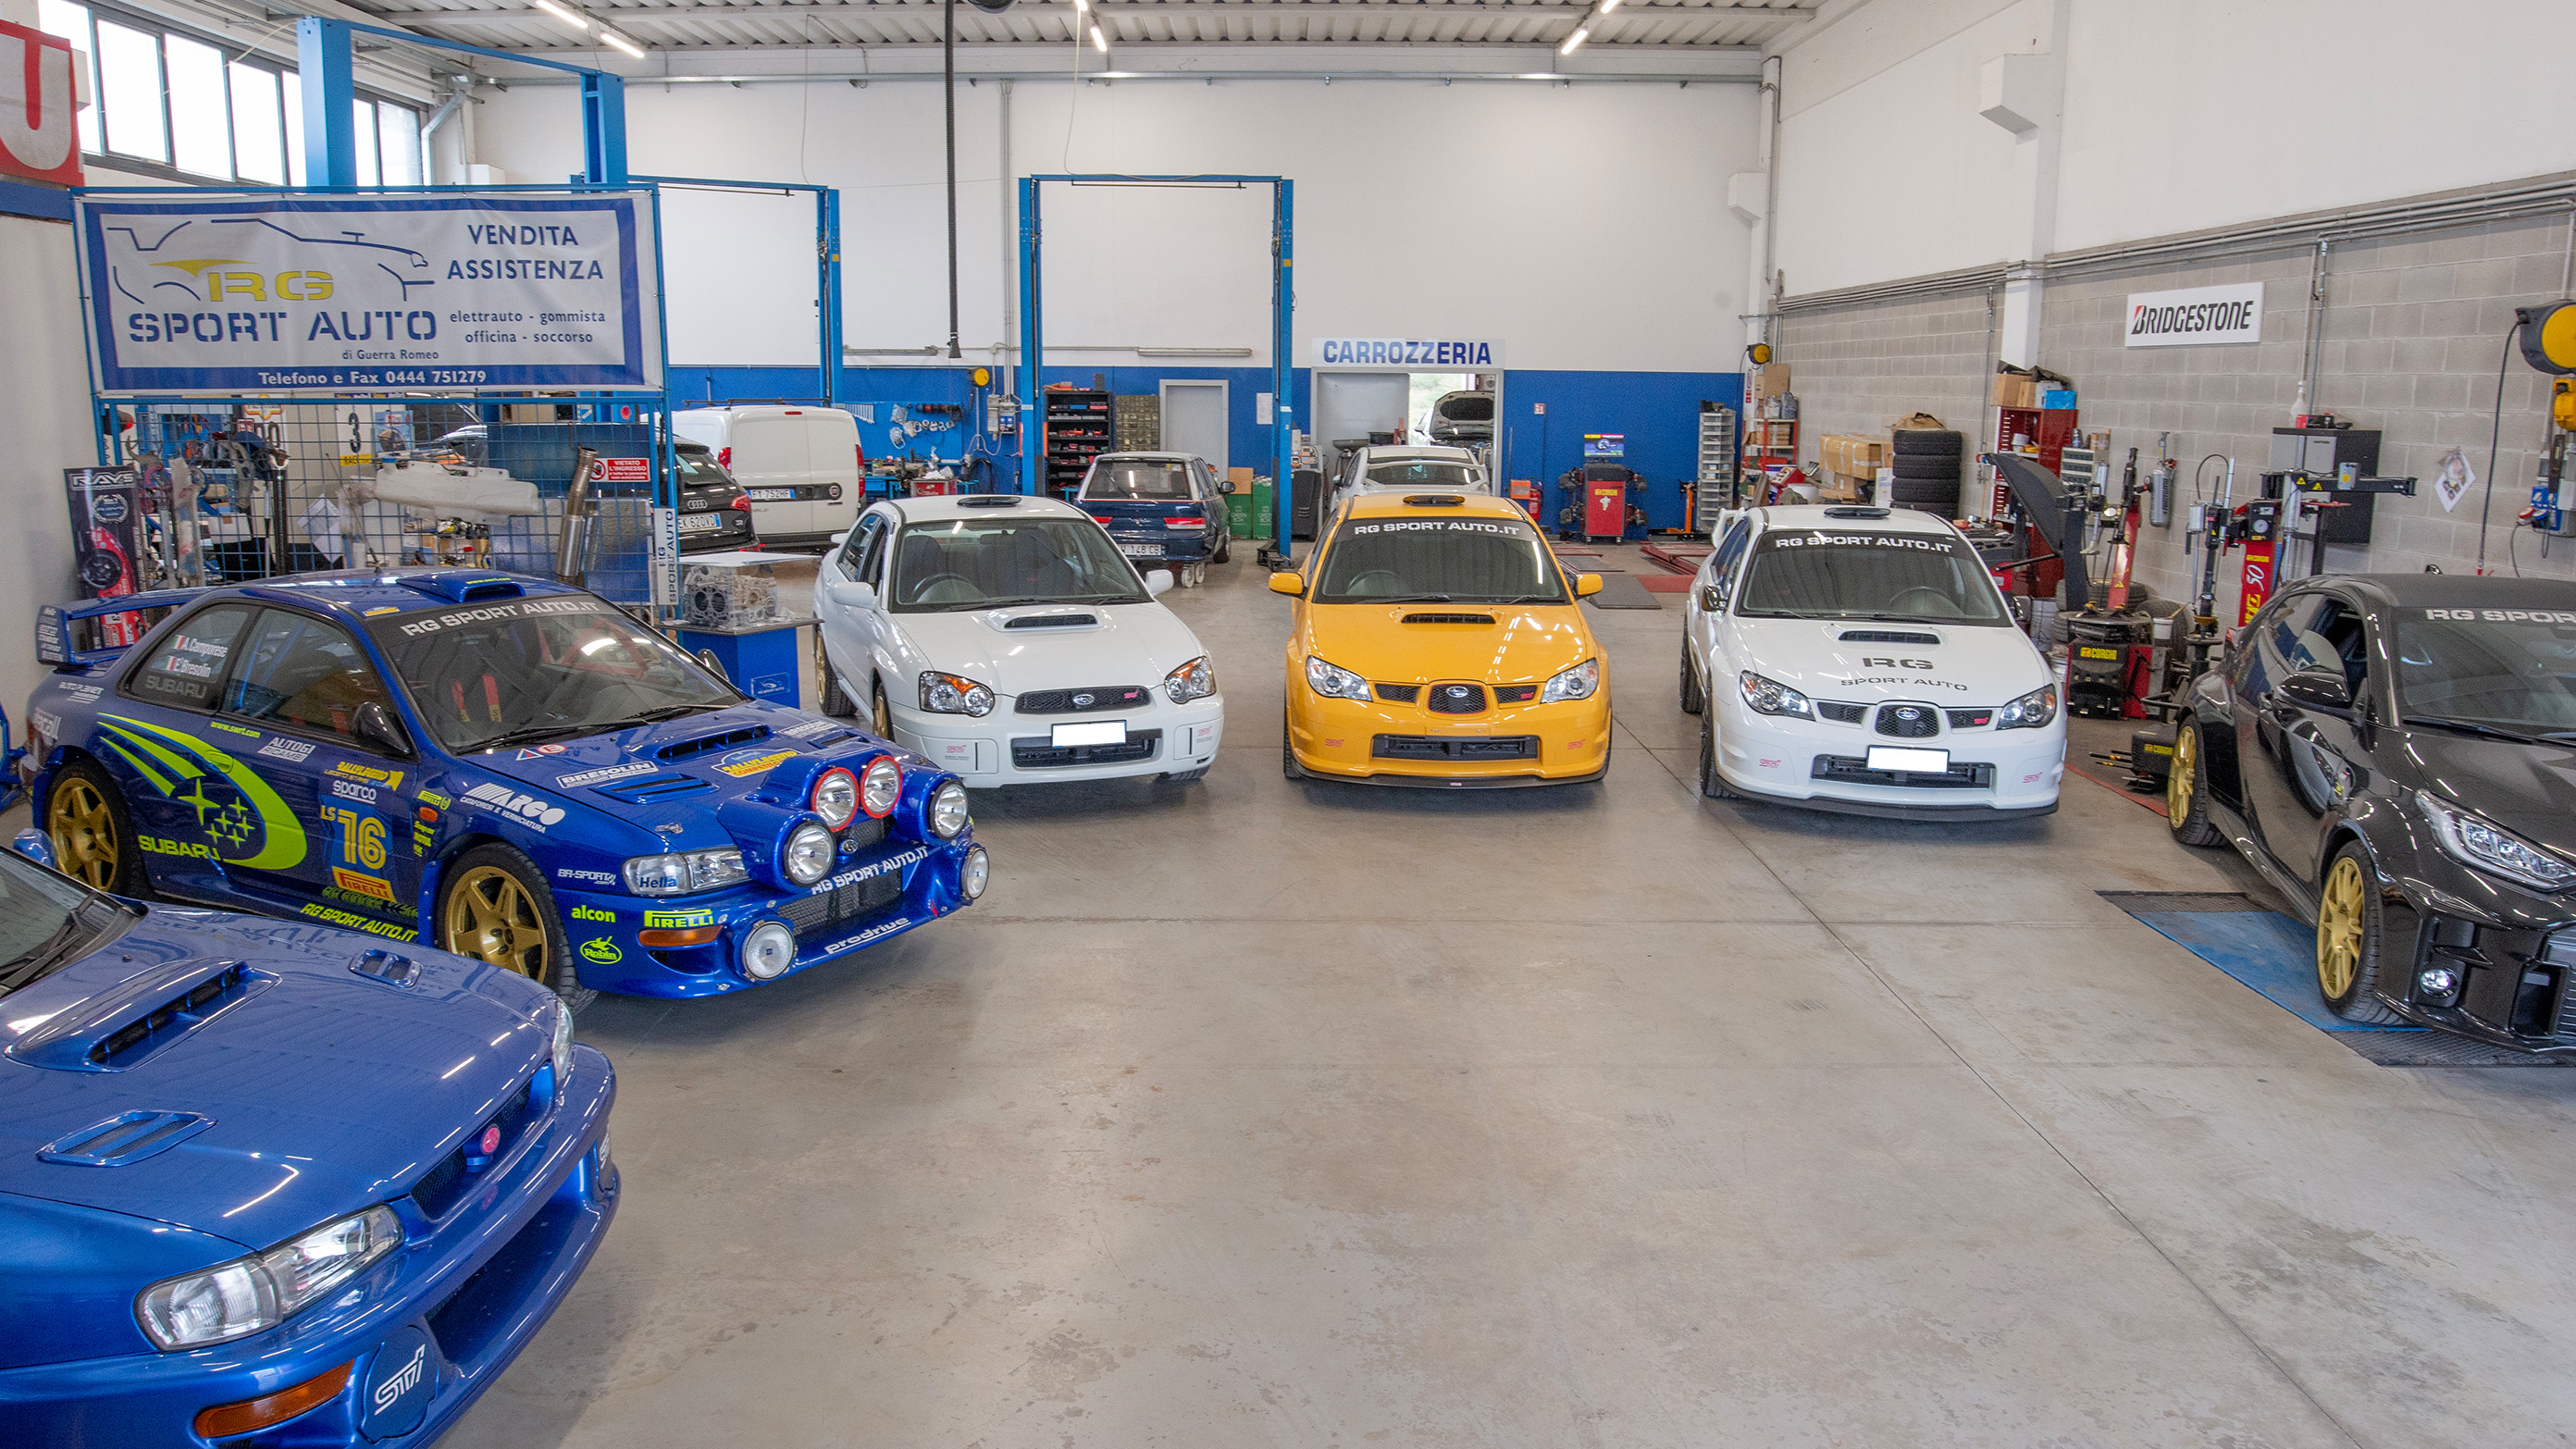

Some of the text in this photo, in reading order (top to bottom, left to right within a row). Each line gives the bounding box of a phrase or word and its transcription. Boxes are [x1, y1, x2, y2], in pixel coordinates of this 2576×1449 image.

[467, 224, 579, 245] VENDITA
[447, 259, 604, 279] ASSISTENZA
[208, 270, 334, 302] RG
[129, 311, 438, 342] SPORT AUTO
[450, 310, 523, 323] elettrauto
[540, 310, 605, 326] gommista
[2131, 300, 2254, 335] BRIDGESTONE
[464, 330, 517, 343] officina
[534, 333, 593, 342] soccorso
[342, 349, 439, 360] di Guerra Romeo
[1323, 341, 1492, 365] CARROZZERIA
[258, 370, 487, 385] Telefono e Fax 0444 751279
[348, 413, 361, 453] 3
[73, 473, 134, 486] RAYS
[665, 511, 675, 551] AUTO
[1355, 522, 1519, 536] RG SPORT AUTO.IT
[1776, 536, 1951, 553] RG SPORT AUTO.IT
[400, 601, 600, 637] RG SPORT AUTO.IT
[2425, 609, 2576, 623] RG SPOR
[1862, 657, 1934, 670] RG
[145, 675, 208, 700] SUBARU
[1840, 676, 1968, 692] SPORT AUTO
[210, 721, 261, 738] www.swrt.com
[561, 763, 650, 784] BRESOLIN
[333, 779, 378, 802] sparco
[320, 805, 336, 822] LS
[460, 796, 496, 812] CATAFORESI
[501, 810, 547, 834] VERNICIATURA
[138, 835, 221, 861] SUBARU
[338, 809, 387, 870] 16
[811, 846, 929, 896] RG SPORT AUTO.IT
[339, 872, 390, 899] PIRELLI
[639, 876, 678, 889] Hella
[301, 903, 418, 942] RG SPORT AUTO.IT
[571, 905, 616, 923] alcon
[644, 909, 713, 928] PIRELLI
[824, 917, 910, 955] prodrive
[584, 947, 617, 960] Robin
